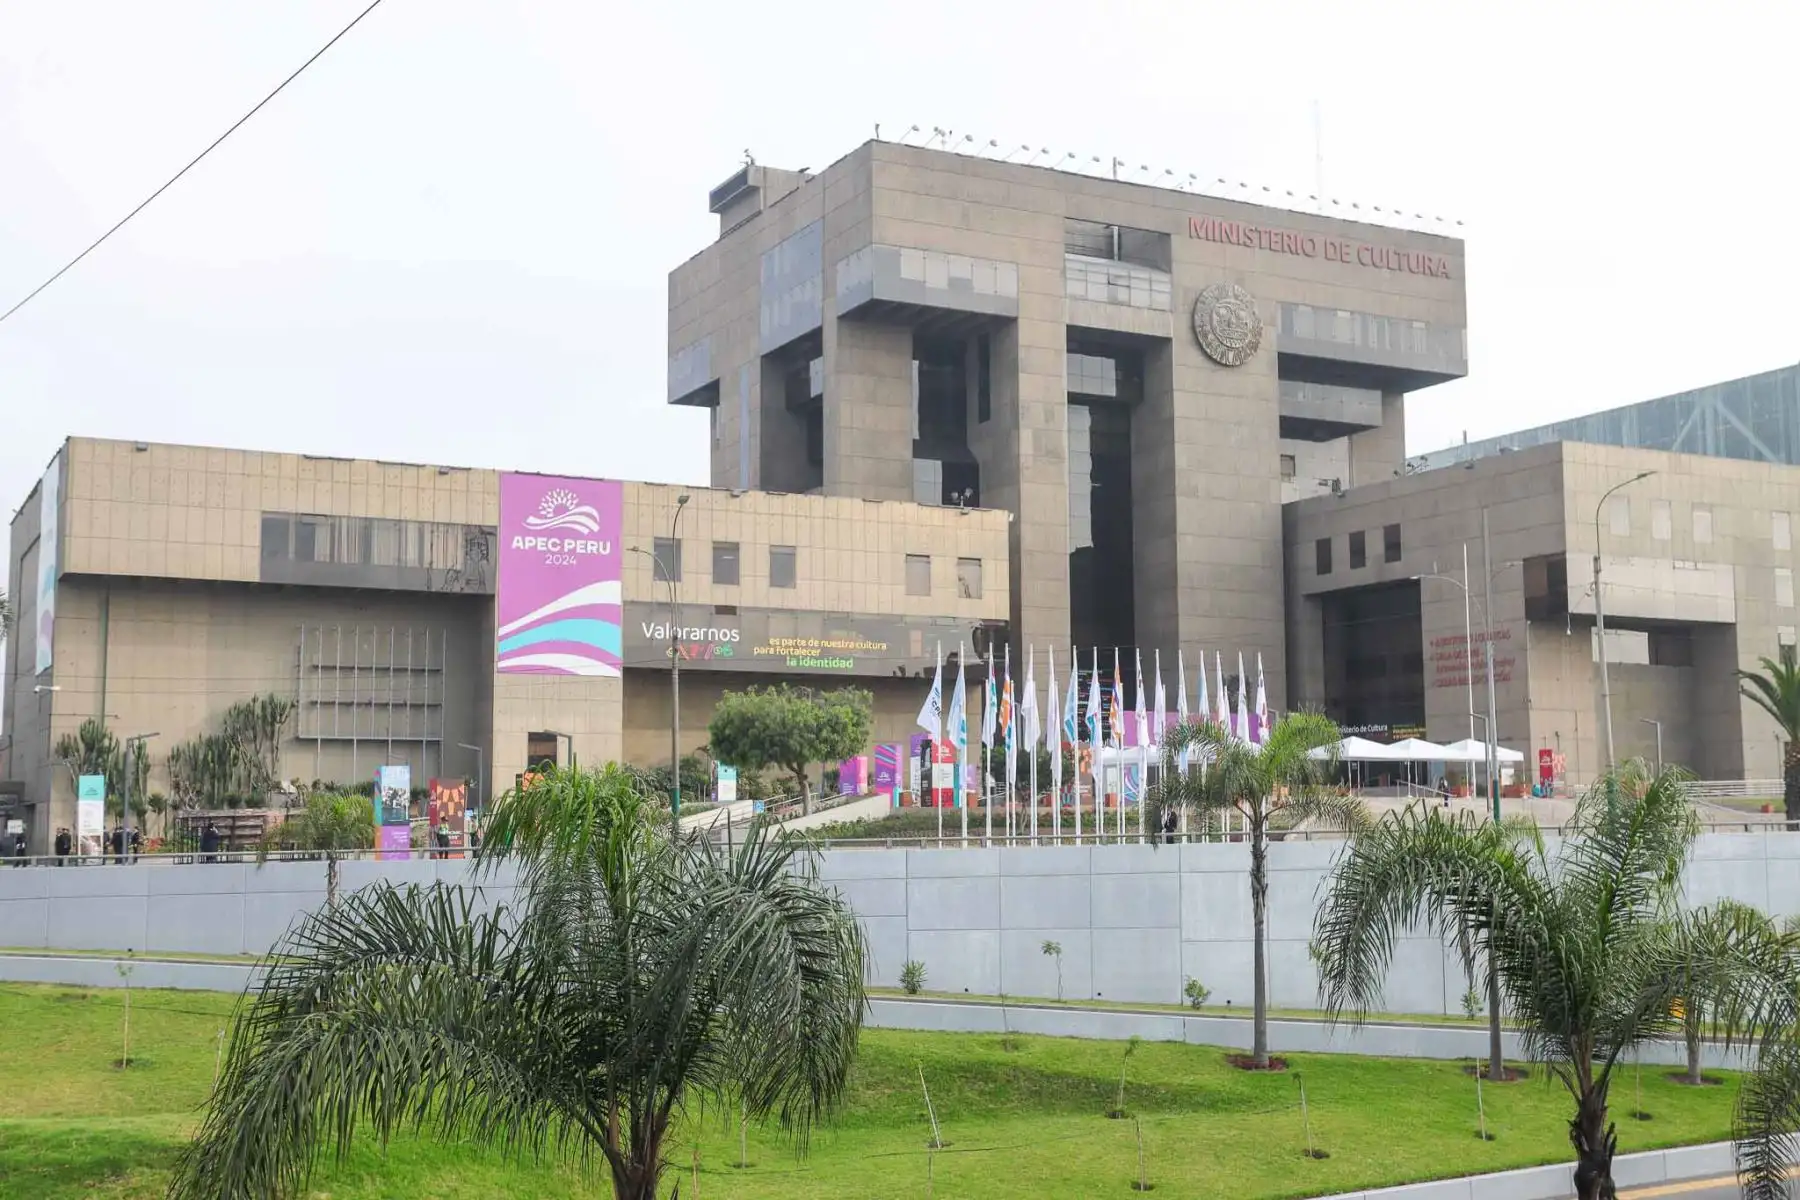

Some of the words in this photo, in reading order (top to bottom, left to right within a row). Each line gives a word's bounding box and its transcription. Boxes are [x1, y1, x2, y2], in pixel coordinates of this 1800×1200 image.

[1188, 214, 1317, 258] MINISTERIO
[1324, 236, 1351, 264] DE
[1357, 244, 1451, 279] CULTURA
[511, 536, 560, 552] APEC
[563, 538, 611, 555] PERU
[545, 554, 576, 565] 2024
[641, 621, 740, 641] Valorarnos
[769, 638, 780, 646] es
[782, 637, 807, 649] parte
[807, 636, 820, 647] de
[821, 639, 854, 648] nuestra
[855, 639, 887, 650] cultura
[753, 647, 774, 656] para
[776, 646, 821, 656] fortalecer
[786, 656, 797, 667] la
[799, 656, 853, 668] identidad
[1360, 724, 1367, 732] de
[1367, 723, 1388, 732] Cultura
